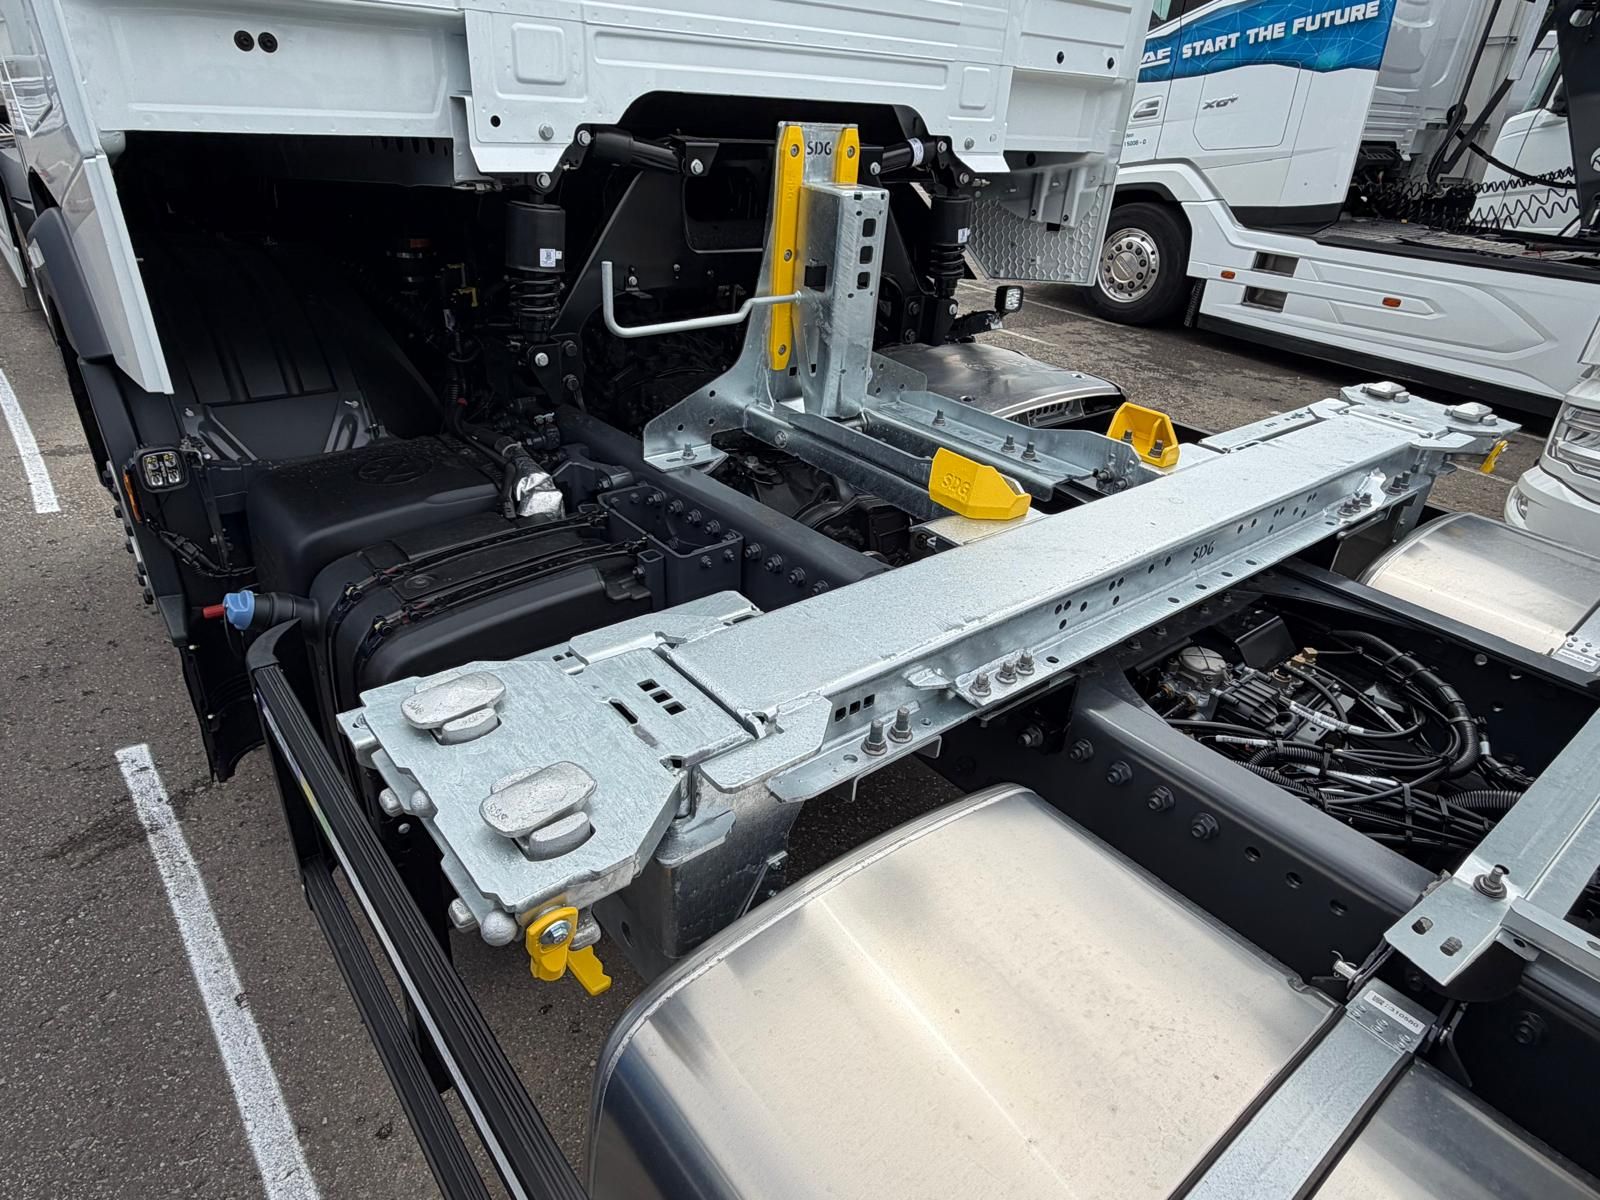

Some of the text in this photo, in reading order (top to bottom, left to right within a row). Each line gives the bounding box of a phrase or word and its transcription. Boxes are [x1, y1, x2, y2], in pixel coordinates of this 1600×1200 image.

[1182, 32, 1240, 59] START
[1246, 21, 1286, 44] THE
[1292, 0, 1380, 35] FUTURE
[806, 141, 832, 156] SDG
[941, 473, 971, 497] SDG
[1191, 540, 1216, 564] SDG
